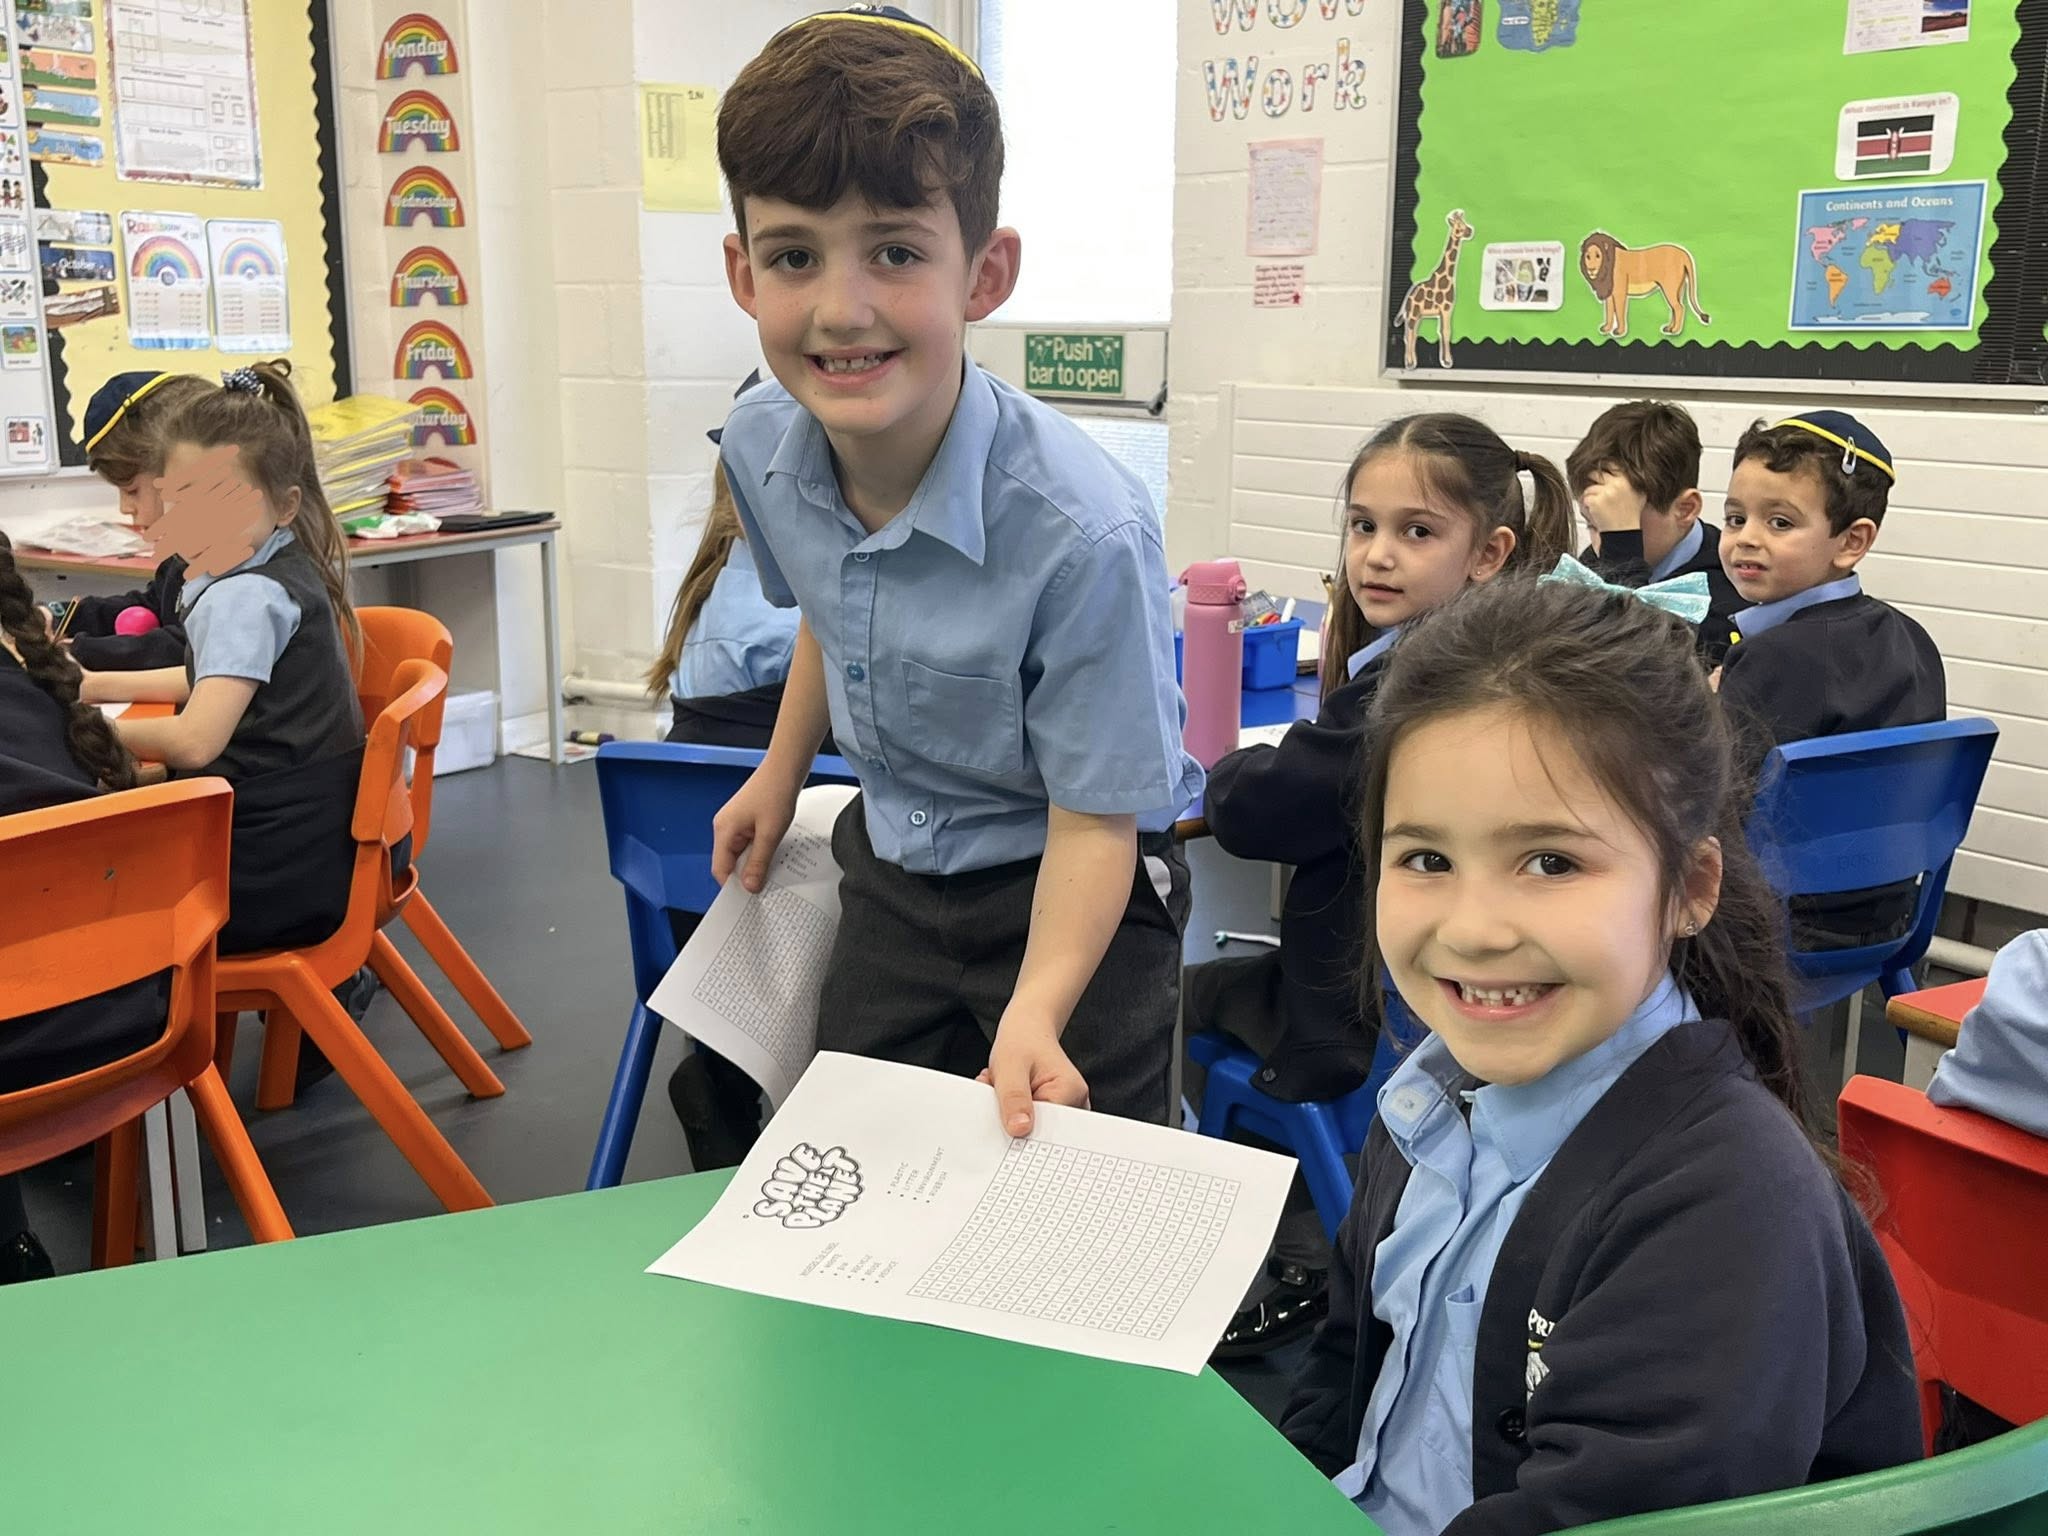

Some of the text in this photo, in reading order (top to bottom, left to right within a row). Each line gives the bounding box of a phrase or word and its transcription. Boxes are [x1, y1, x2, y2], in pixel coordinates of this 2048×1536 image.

[384, 36, 448, 60] Monday
[1202, 37, 1367, 122] Work
[385, 113, 450, 139] Tuesday
[391, 193, 457, 212] Wednesday
[1826, 196, 1953, 212] Continents and Oceans
[396, 271, 458, 292] Thursday
[407, 341, 456, 366] Friday
[1053, 336, 1093, 361] Push
[1028, 361, 1119, 391] bar to open
[753, 1142, 822, 1218] SAVE
[890, 1162, 909, 1187] PLASTIC
[904, 1169, 919, 1191] LITTER
[915, 1147, 944, 1193] ENVIRONMENT
[782, 1146, 863, 1229] PLANET
[791, 1171, 832, 1209] THE
